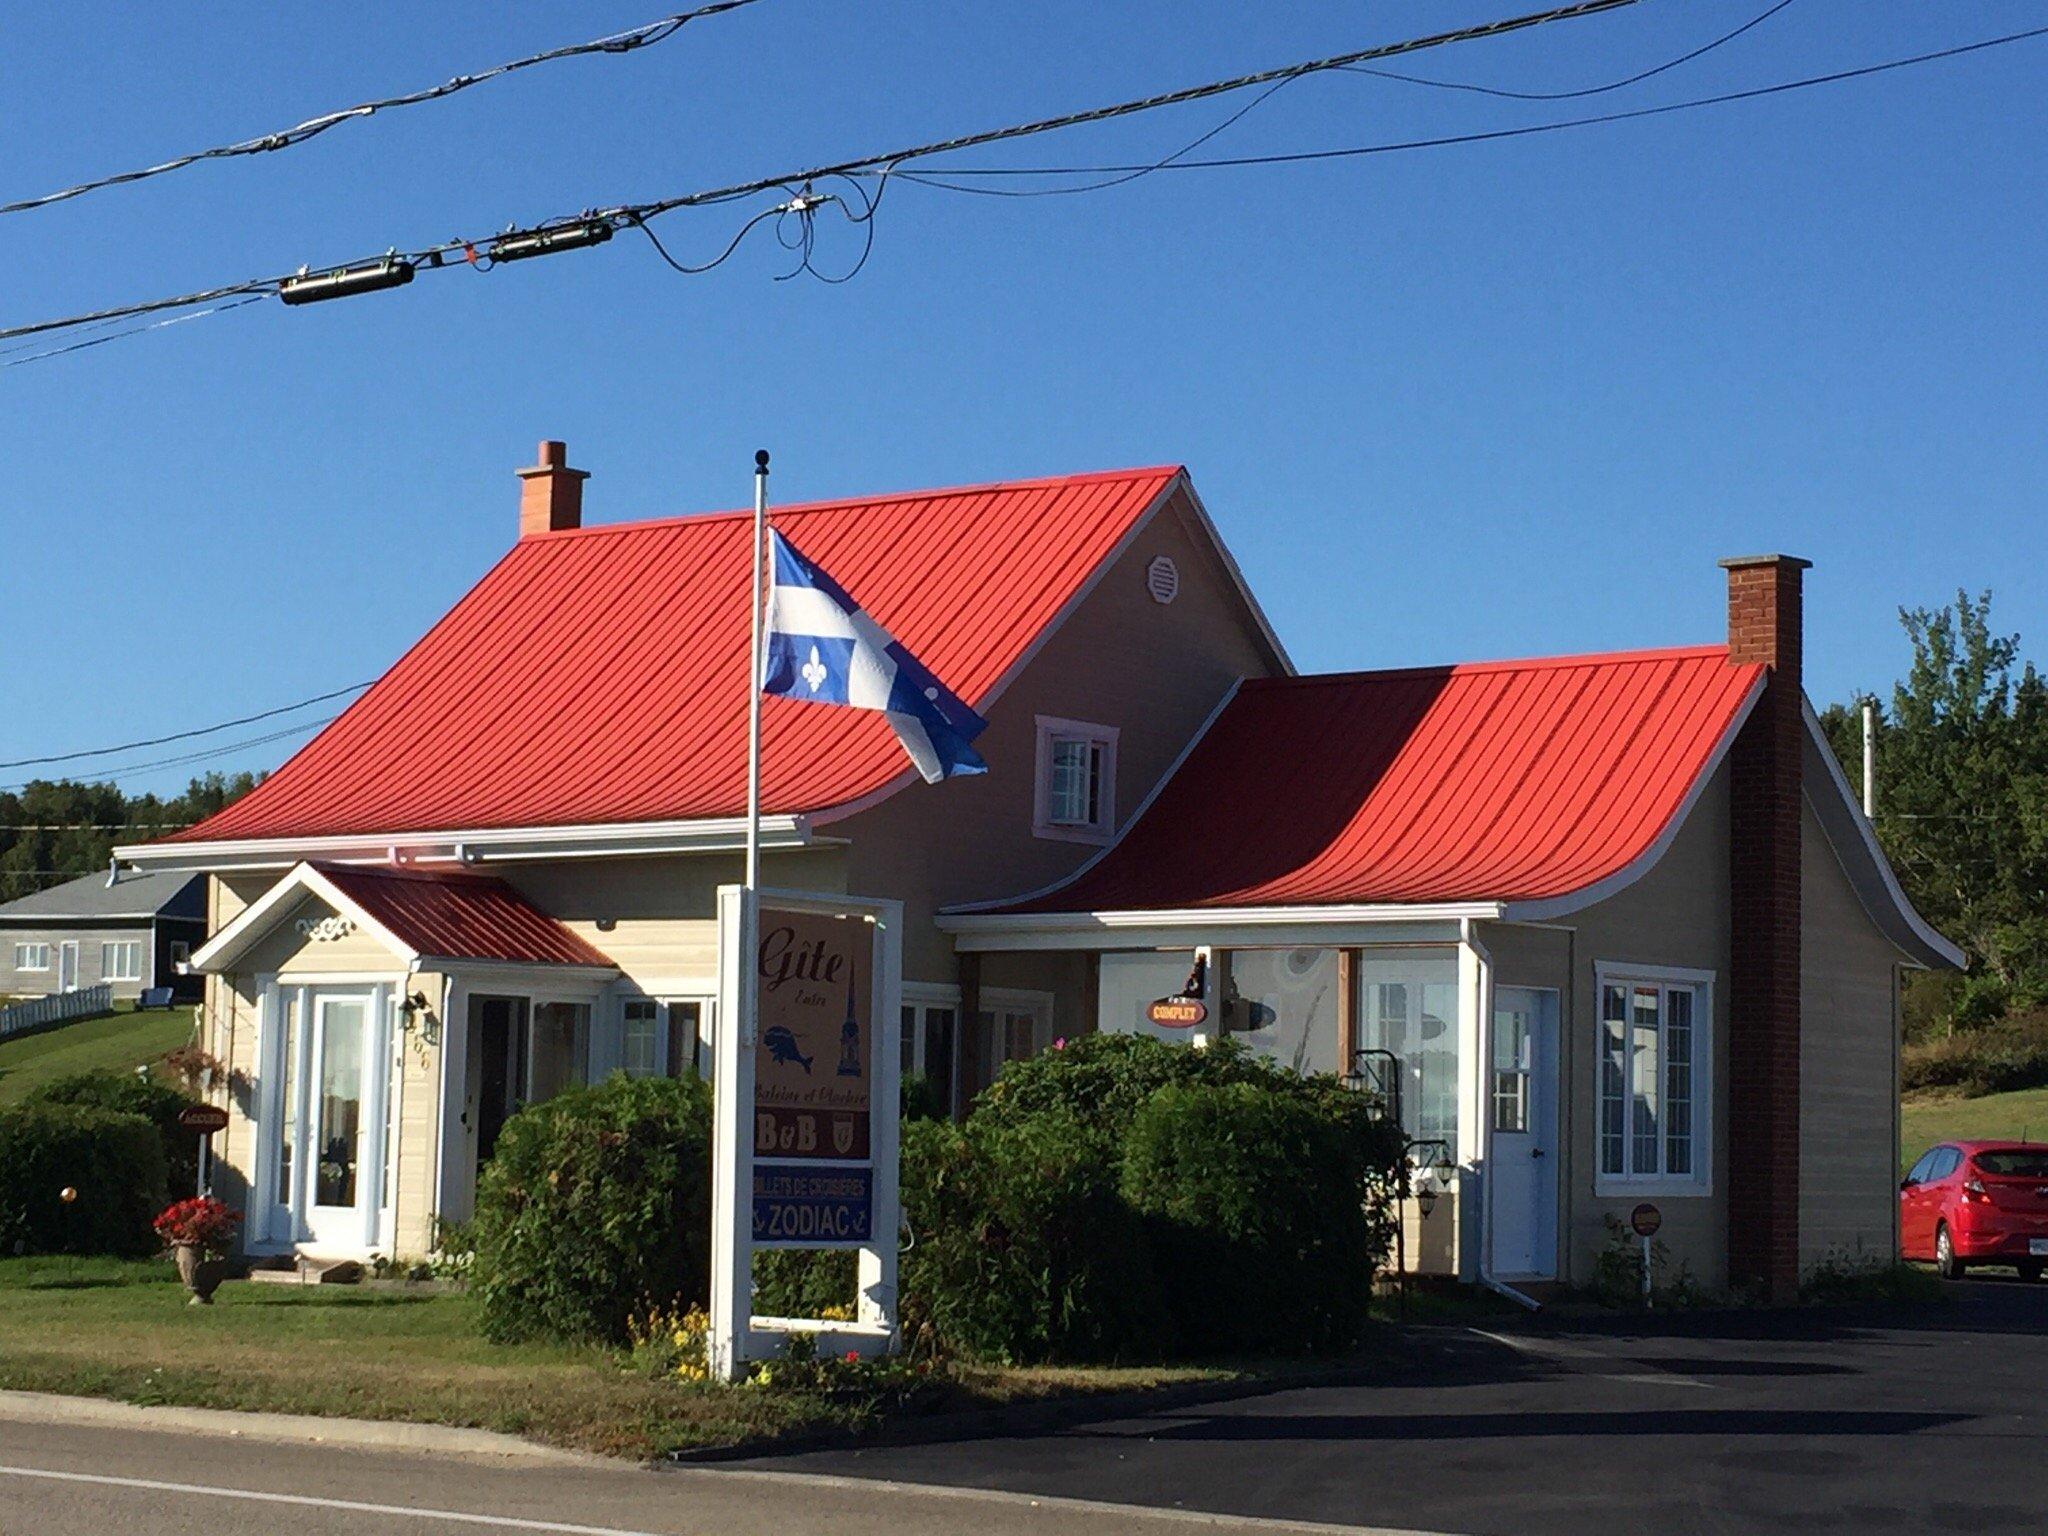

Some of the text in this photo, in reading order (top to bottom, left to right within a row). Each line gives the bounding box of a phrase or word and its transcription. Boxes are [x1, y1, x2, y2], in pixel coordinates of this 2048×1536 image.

[758, 927, 843, 991] Gîte
[1153, 1006, 1196, 1020] COMPLET
[768, 1205, 849, 1236] ZODIAC
